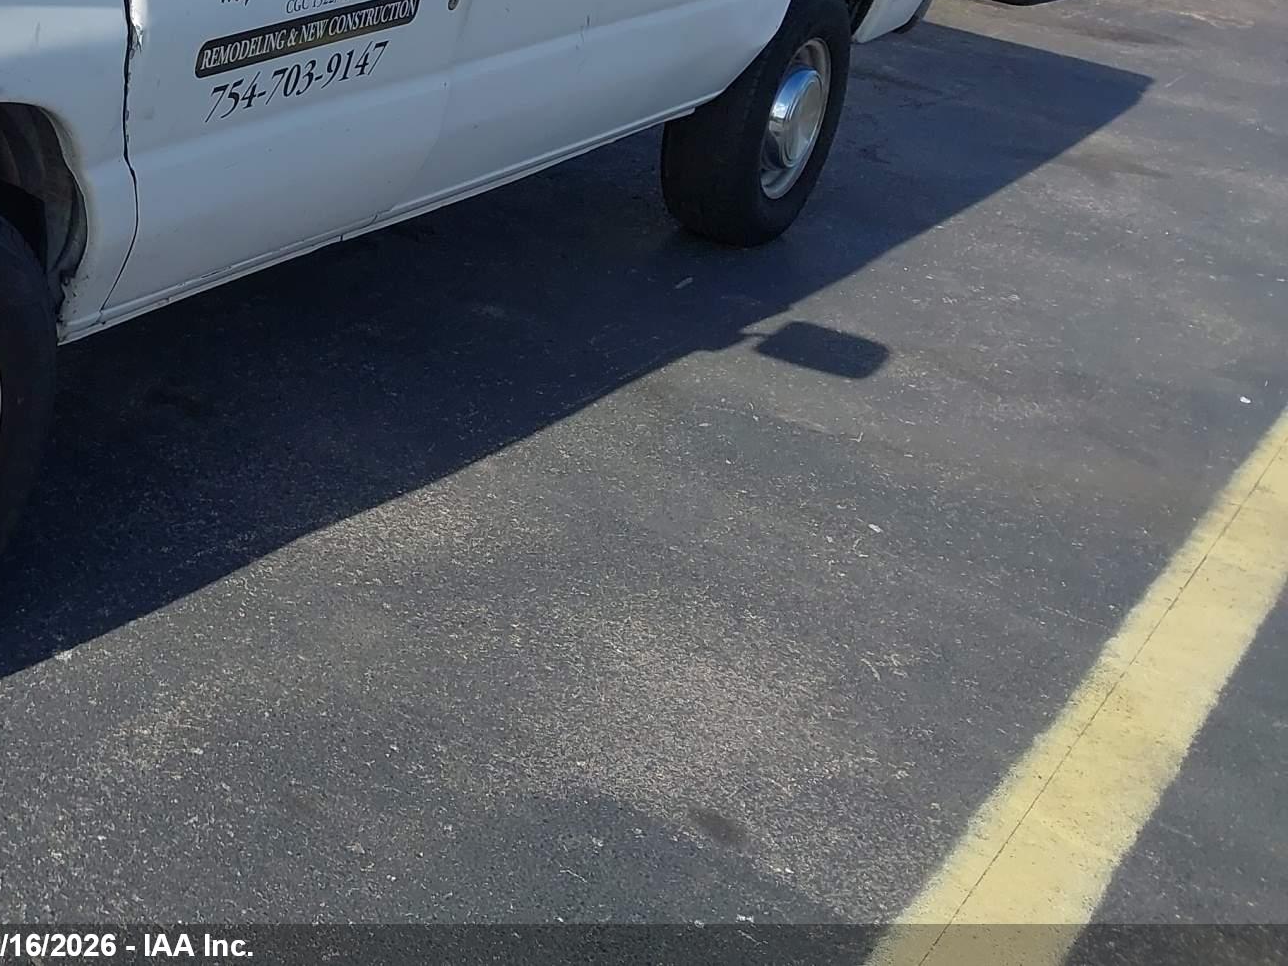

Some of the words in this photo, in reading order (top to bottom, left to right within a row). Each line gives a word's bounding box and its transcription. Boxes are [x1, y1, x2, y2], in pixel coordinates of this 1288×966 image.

[199, 28, 287, 71] REMODELING
[287, 27, 298, 47] &
[298, 19, 330, 45] NEW
[204, 40, 390, 123] 754-703-9147
